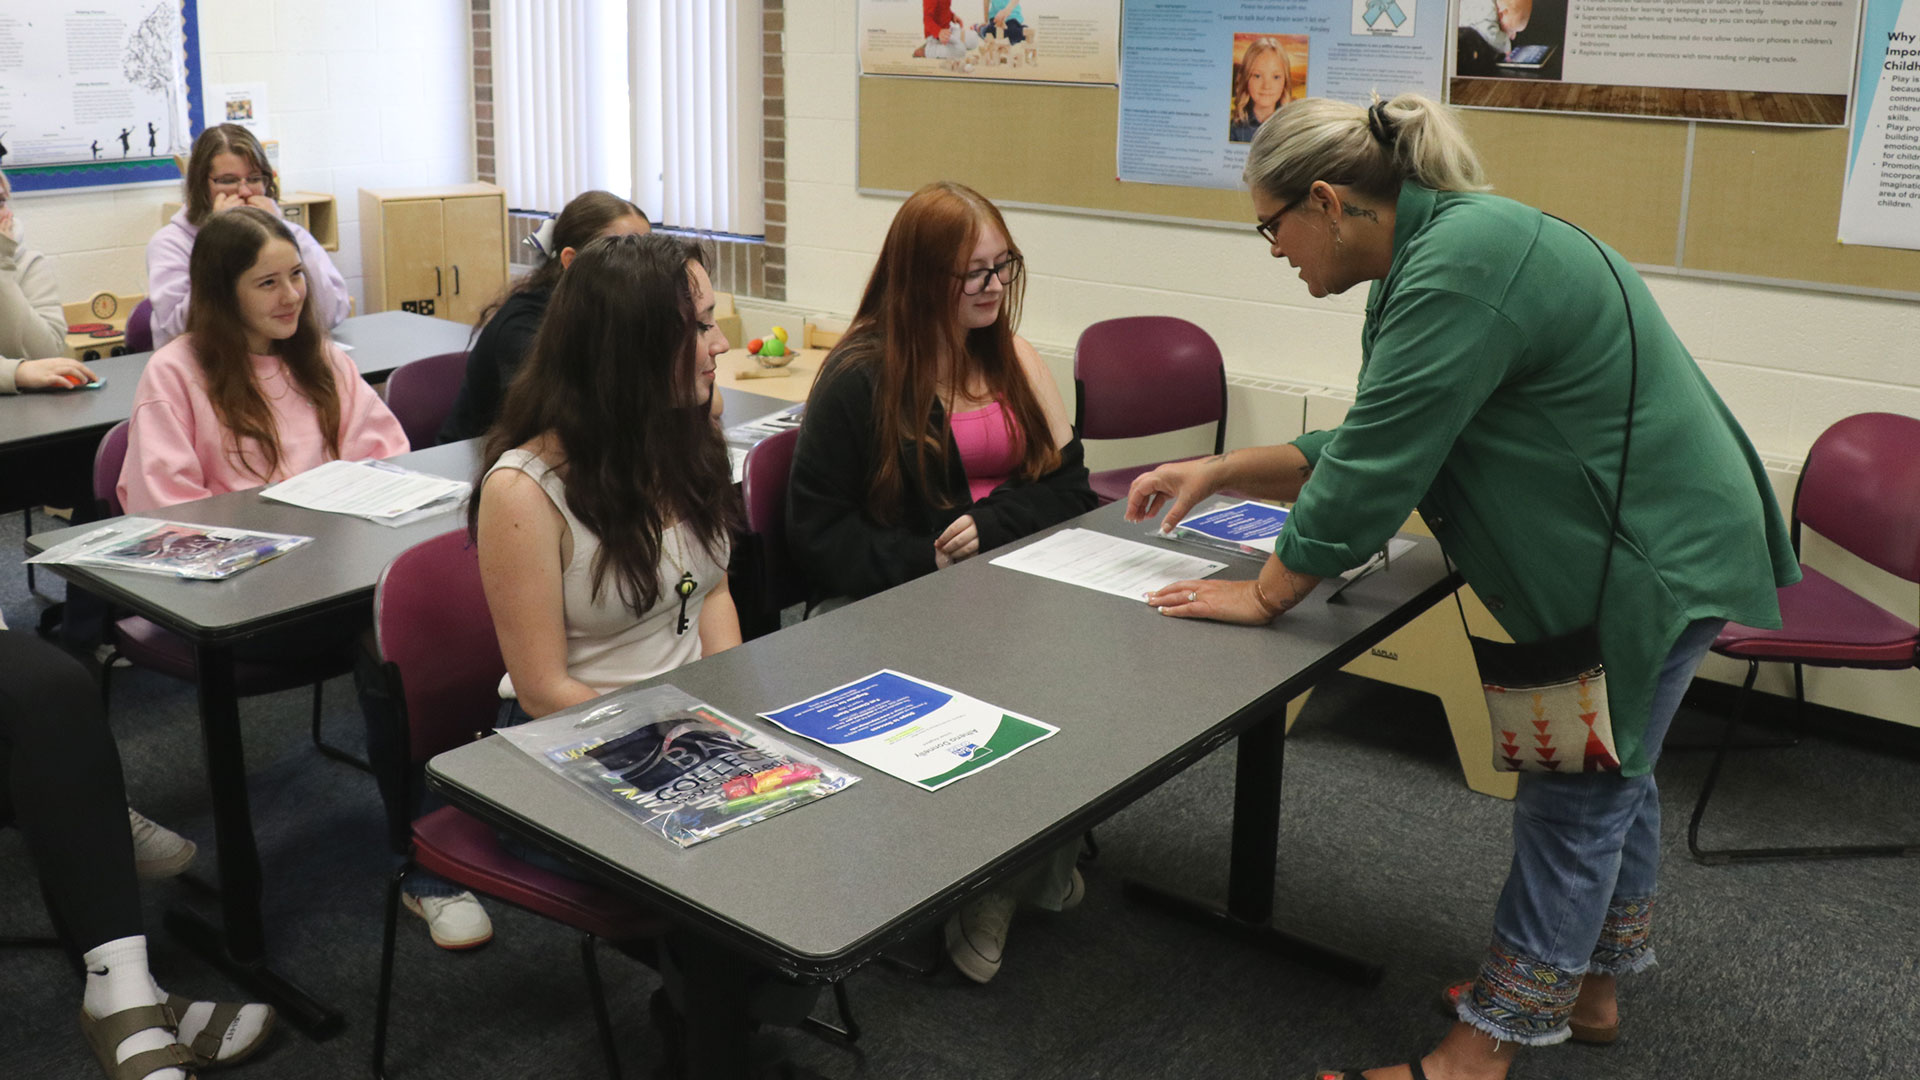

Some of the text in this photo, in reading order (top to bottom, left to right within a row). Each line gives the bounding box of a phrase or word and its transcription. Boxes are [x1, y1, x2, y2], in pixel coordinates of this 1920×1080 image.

[1888, 32, 1916, 44] Why
[1892, 75, 1910, 84] Play
[1886, 123, 1904, 132] Play
[1885, 133, 1918, 142] building
[1878, 200, 1913, 208] children.
[655, 748, 781, 803] COLLEGE
